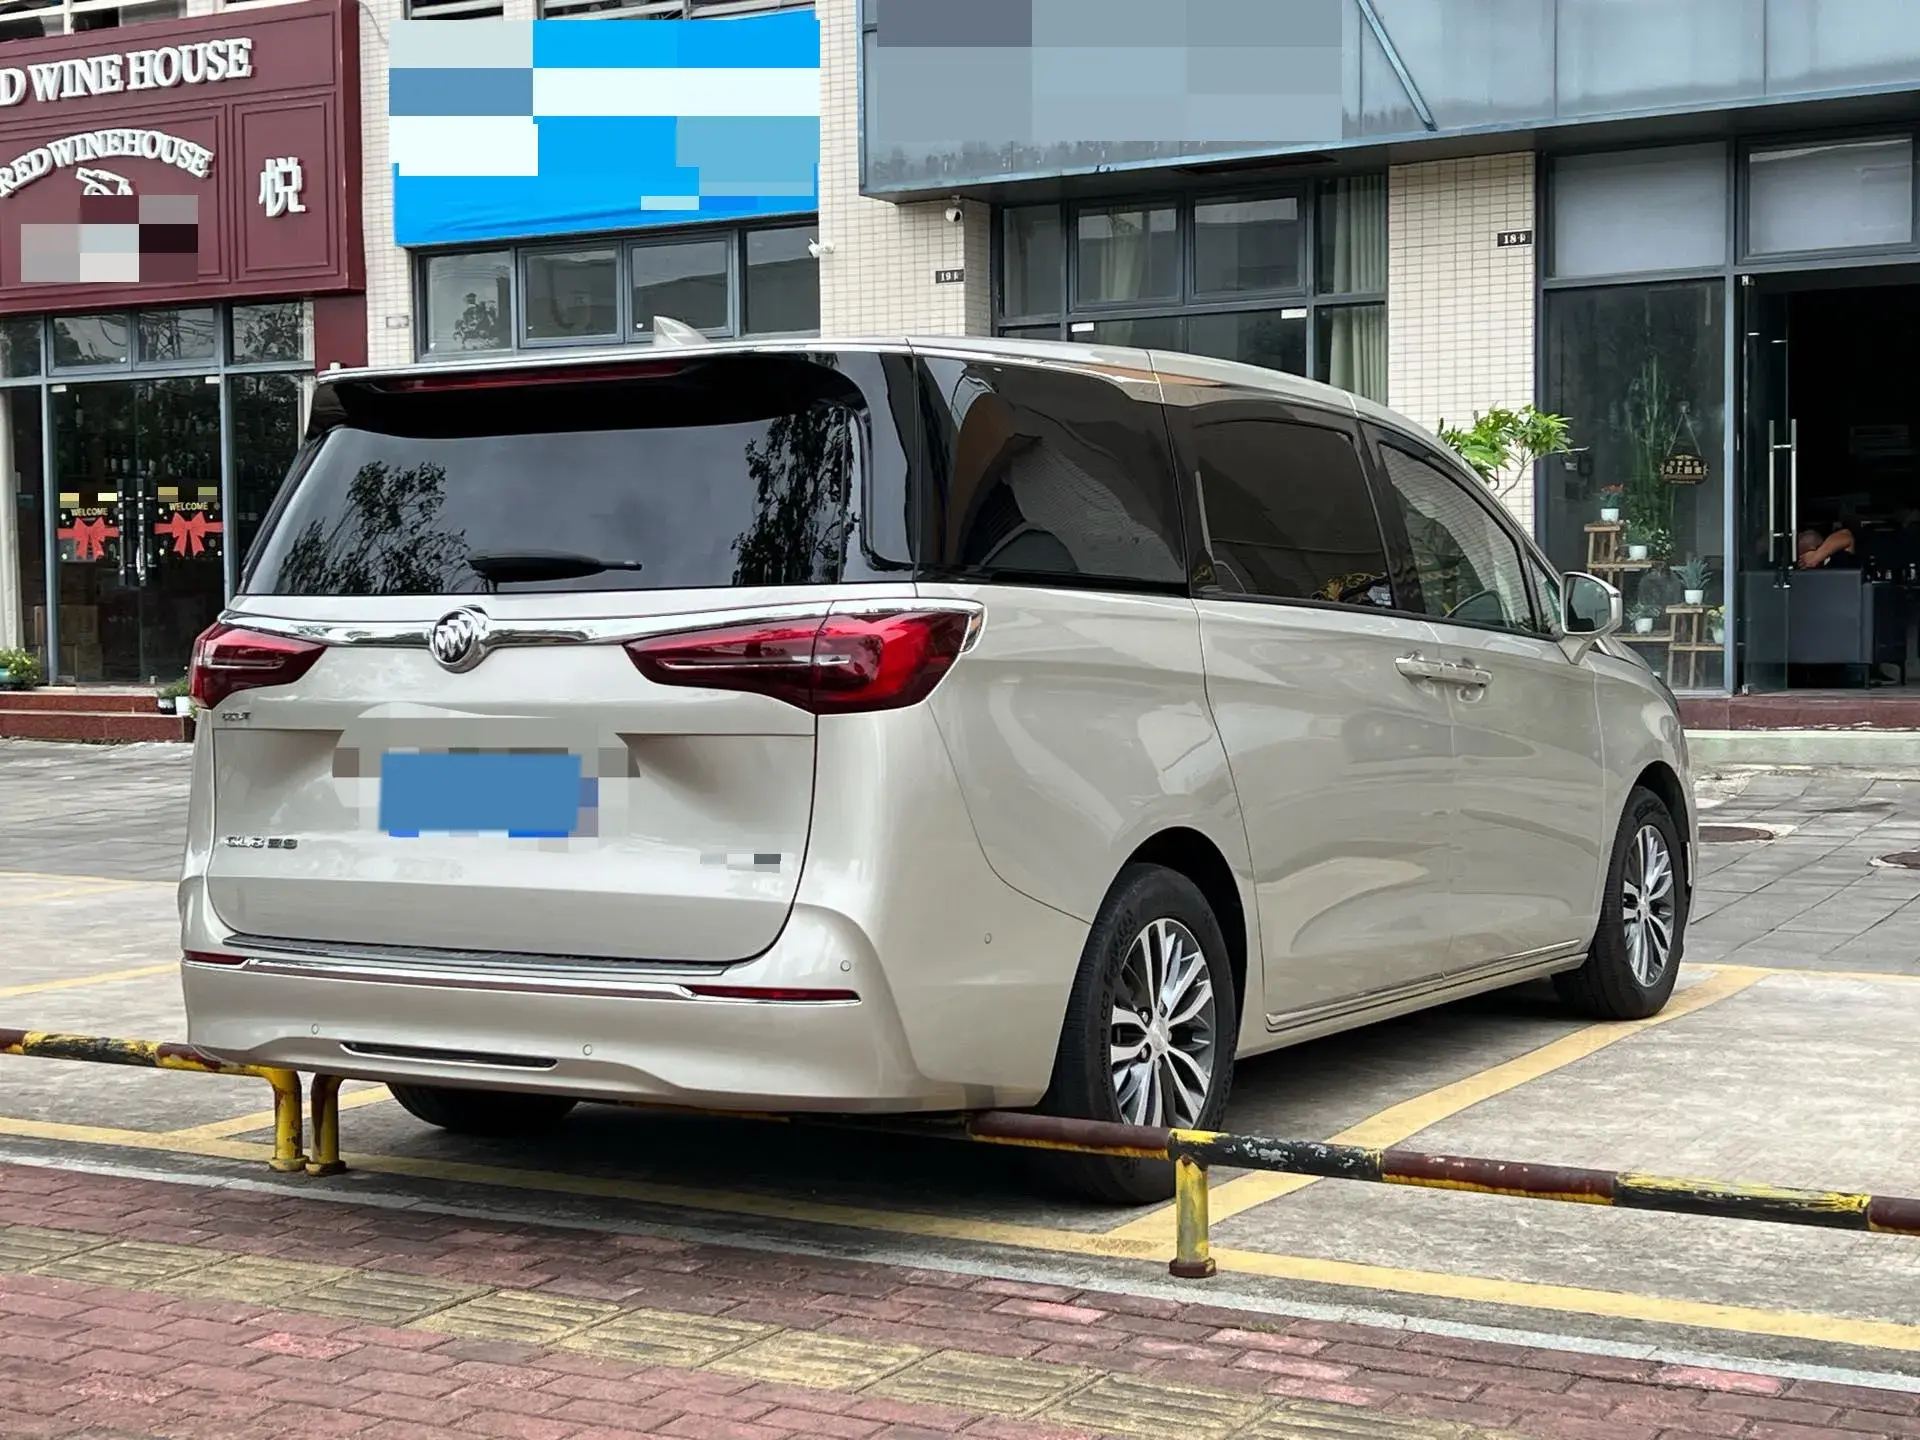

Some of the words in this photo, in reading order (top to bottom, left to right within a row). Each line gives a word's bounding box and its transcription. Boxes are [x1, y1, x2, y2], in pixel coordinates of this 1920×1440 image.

[27, 54, 123, 102] WINE
[127, 37, 252, 90] HOUSE
[259, 156, 306, 217] 悦
[71, 507, 108, 516] WELCOME
[169, 501, 208, 511] WELCOME
